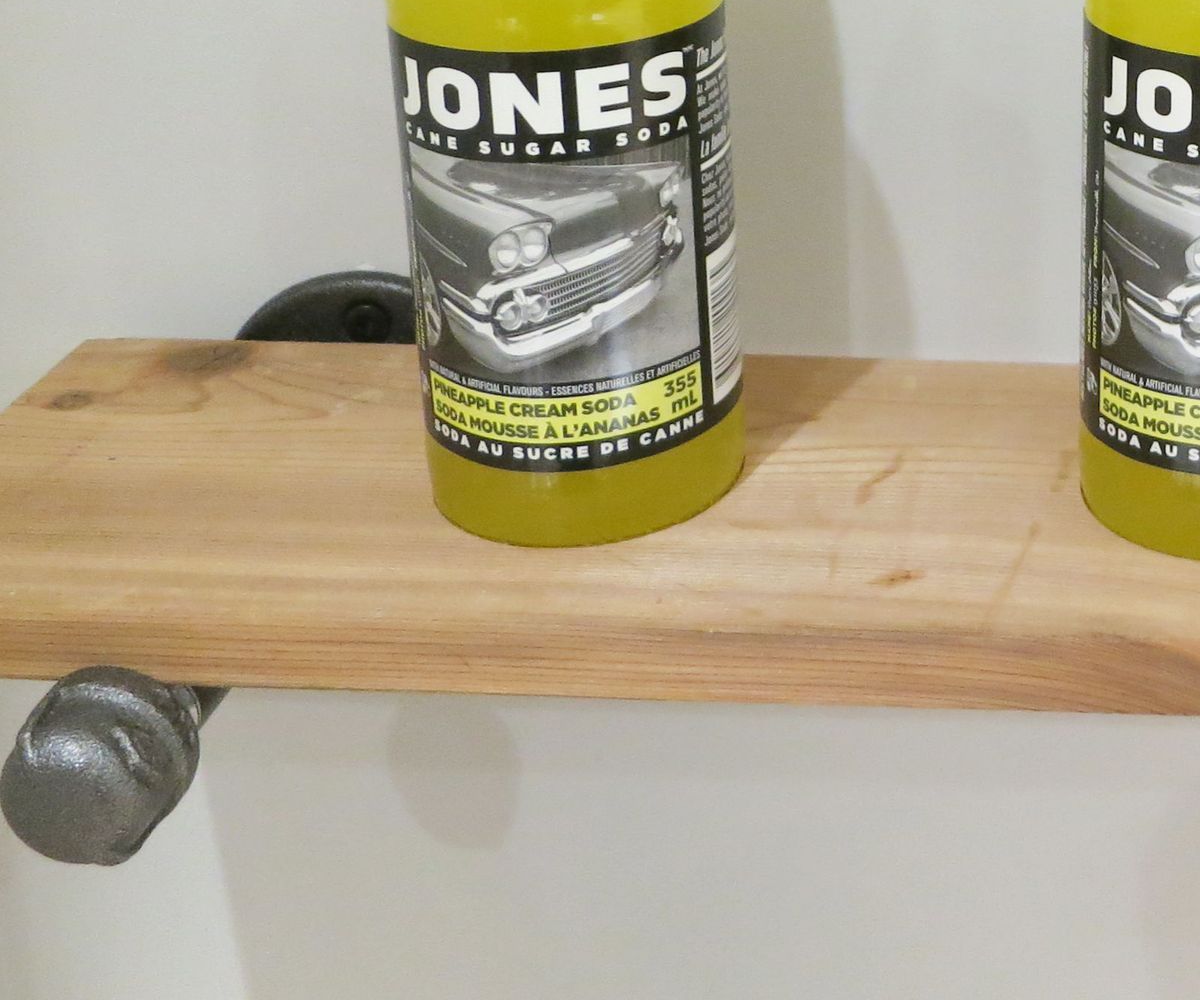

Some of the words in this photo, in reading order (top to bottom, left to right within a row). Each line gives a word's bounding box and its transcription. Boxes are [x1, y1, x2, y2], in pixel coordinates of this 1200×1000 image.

[402, 51, 687, 135] JONES
[405, 120, 458, 150] CANE
[478, 138, 592, 157] SUGAR
[615, 115, 689, 147] SODA
[1103, 120, 1164, 152] CANE
[434, 377, 506, 415] PINEAPPLE
[509, 402, 578, 418] CREAM
[582, 393, 637, 416] SODA
[468, 378, 502, 394] ARTIFICIAL
[503, 384, 544, 397] FLAVOURS
[551, 383, 594, 396] ESSENCES
[596, 372, 645, 392] NATURELLES
[646, 368, 656, 379] ET
[664, 370, 697, 398] 355
[671, 390, 699, 414] mL
[1103, 376, 1185, 417] PINEAPPLE
[1146, 378, 1184, 396] ARTIFICIAL
[436, 399, 468, 426] SODA
[470, 416, 540, 440] MOUSSE
[542, 421, 559, 440] À
[562, 406, 660, 439] L'ANANAS
[1102, 398, 1140, 427] SODA
[434, 418, 471, 449] SODA
[478, 440, 503, 457] AU
[512, 446, 590, 460] SUCRE
[600, 440, 629, 455] DE
[639, 410, 704, 446] CANNE
[1098, 416, 1142, 450] SODA
[1150, 440, 1178, 458] AU
